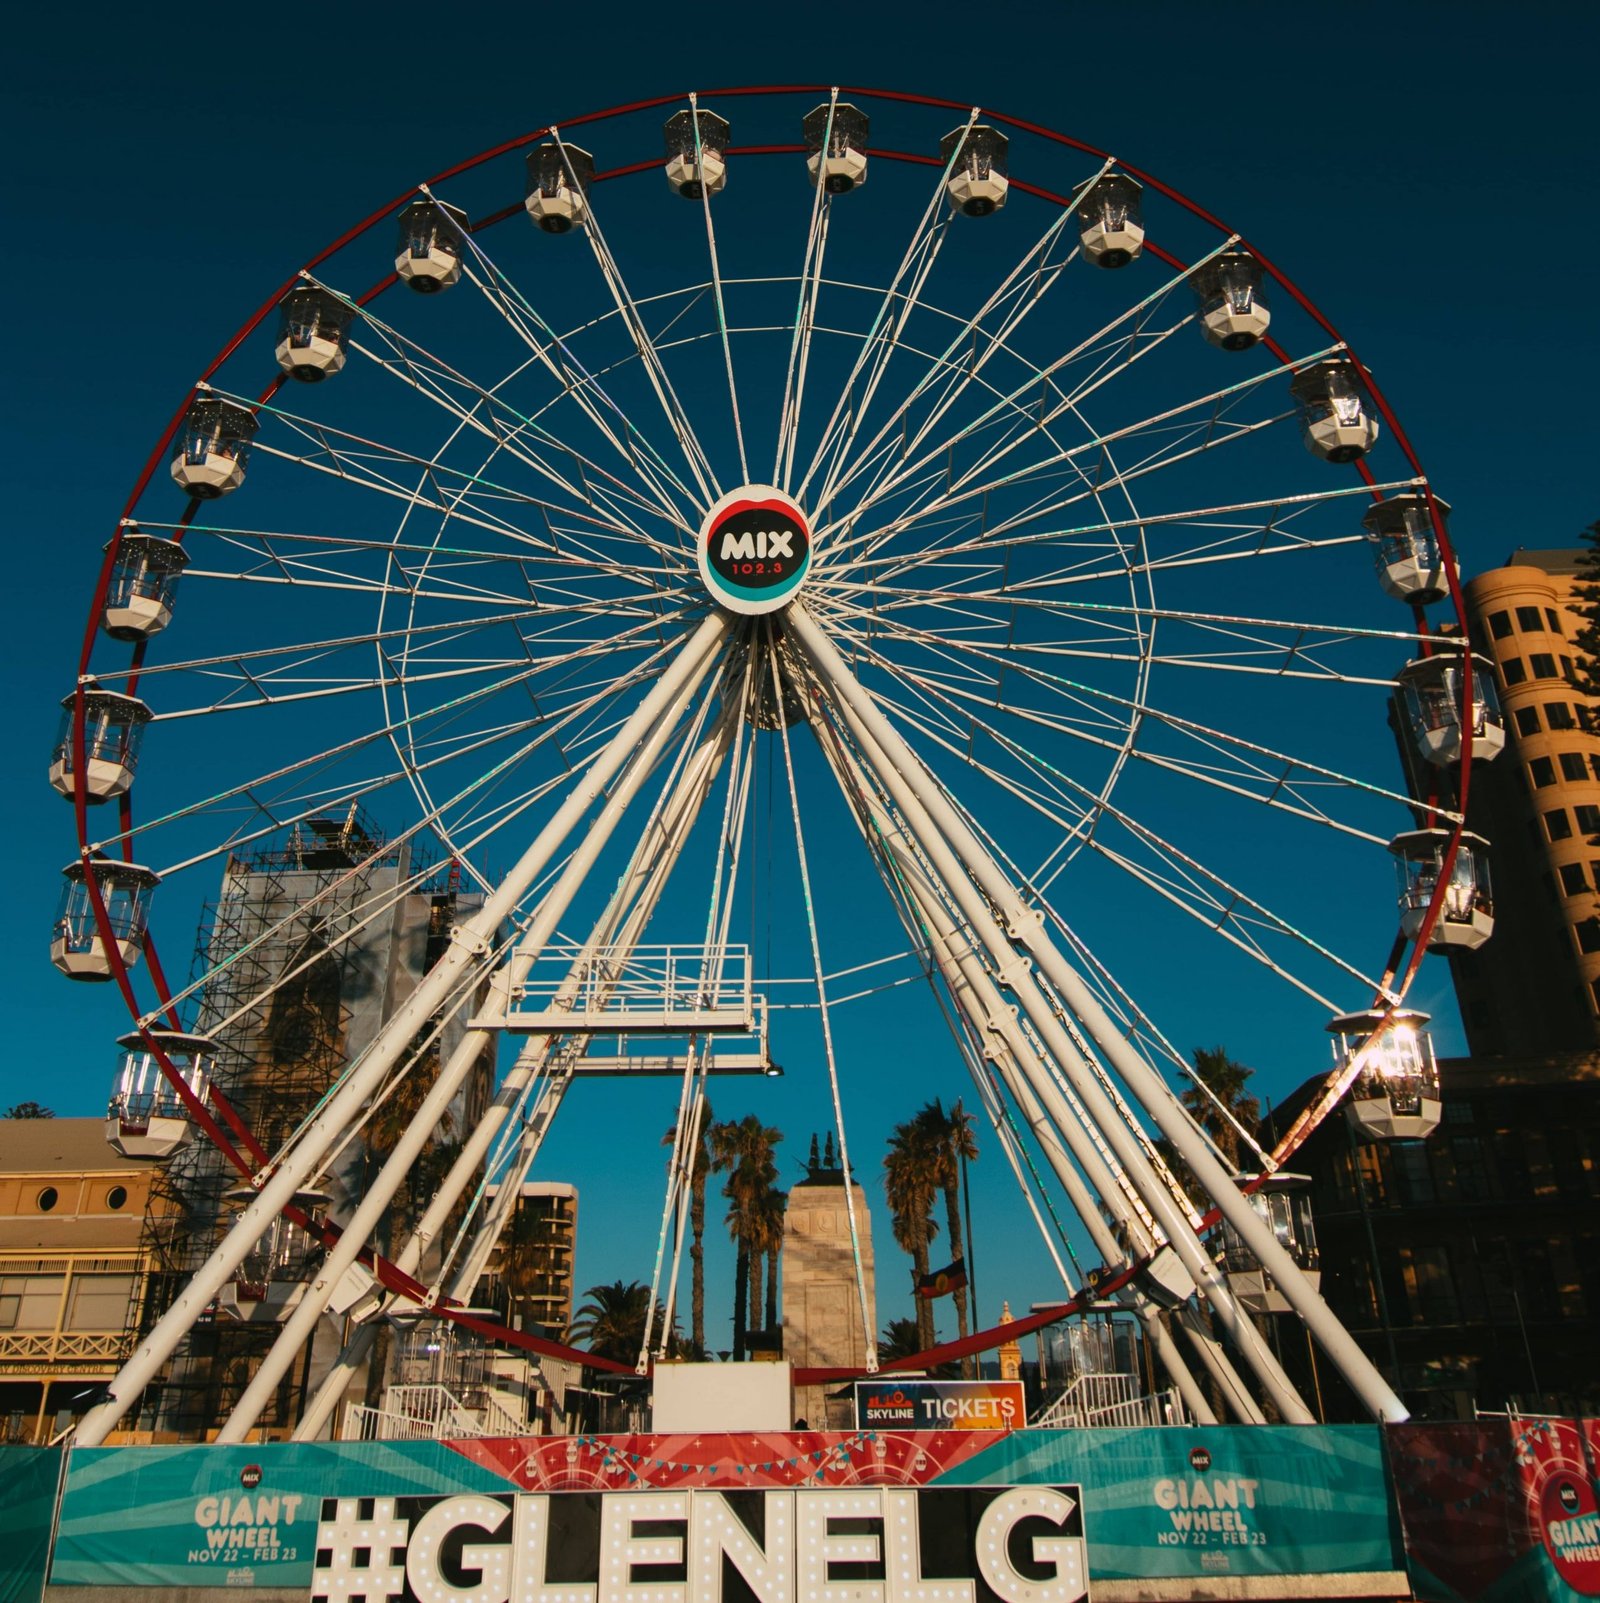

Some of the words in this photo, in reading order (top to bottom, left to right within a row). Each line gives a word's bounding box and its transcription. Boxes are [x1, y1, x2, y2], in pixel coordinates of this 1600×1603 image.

[721, 531, 793, 560] MIX
[732, 563, 782, 575] 102.3
[12, 1364, 65, 1374] DISCOVERY
[68, 1364, 105, 1374] CENTRE
[867, 1409, 914, 1419] SKYLINE
[921, 1398, 1015, 1419] TICKETS
[1192, 1456, 1209, 1465] MIX
[242, 1474, 259, 1482] MIX
[1154, 1478, 1258, 1510] GIANT
[195, 1495, 302, 1528] GIANT
[1169, 1511, 1247, 1531] WHEEL
[206, 1527, 281, 1549] WHEEL
[311, 1486, 1089, 1603] #GLENELG
[1157, 1532, 1188, 1544] NOV
[1192, 1532, 1207, 1544] 22
[1222, 1532, 1248, 1544] FEB
[1252, 1533, 1267, 1545] 23
[188, 1550, 219, 1562] NOV
[223, 1549, 238, 1562] 22
[254, 1548, 278, 1560] FEB
[282, 1548, 297, 1560] 23
